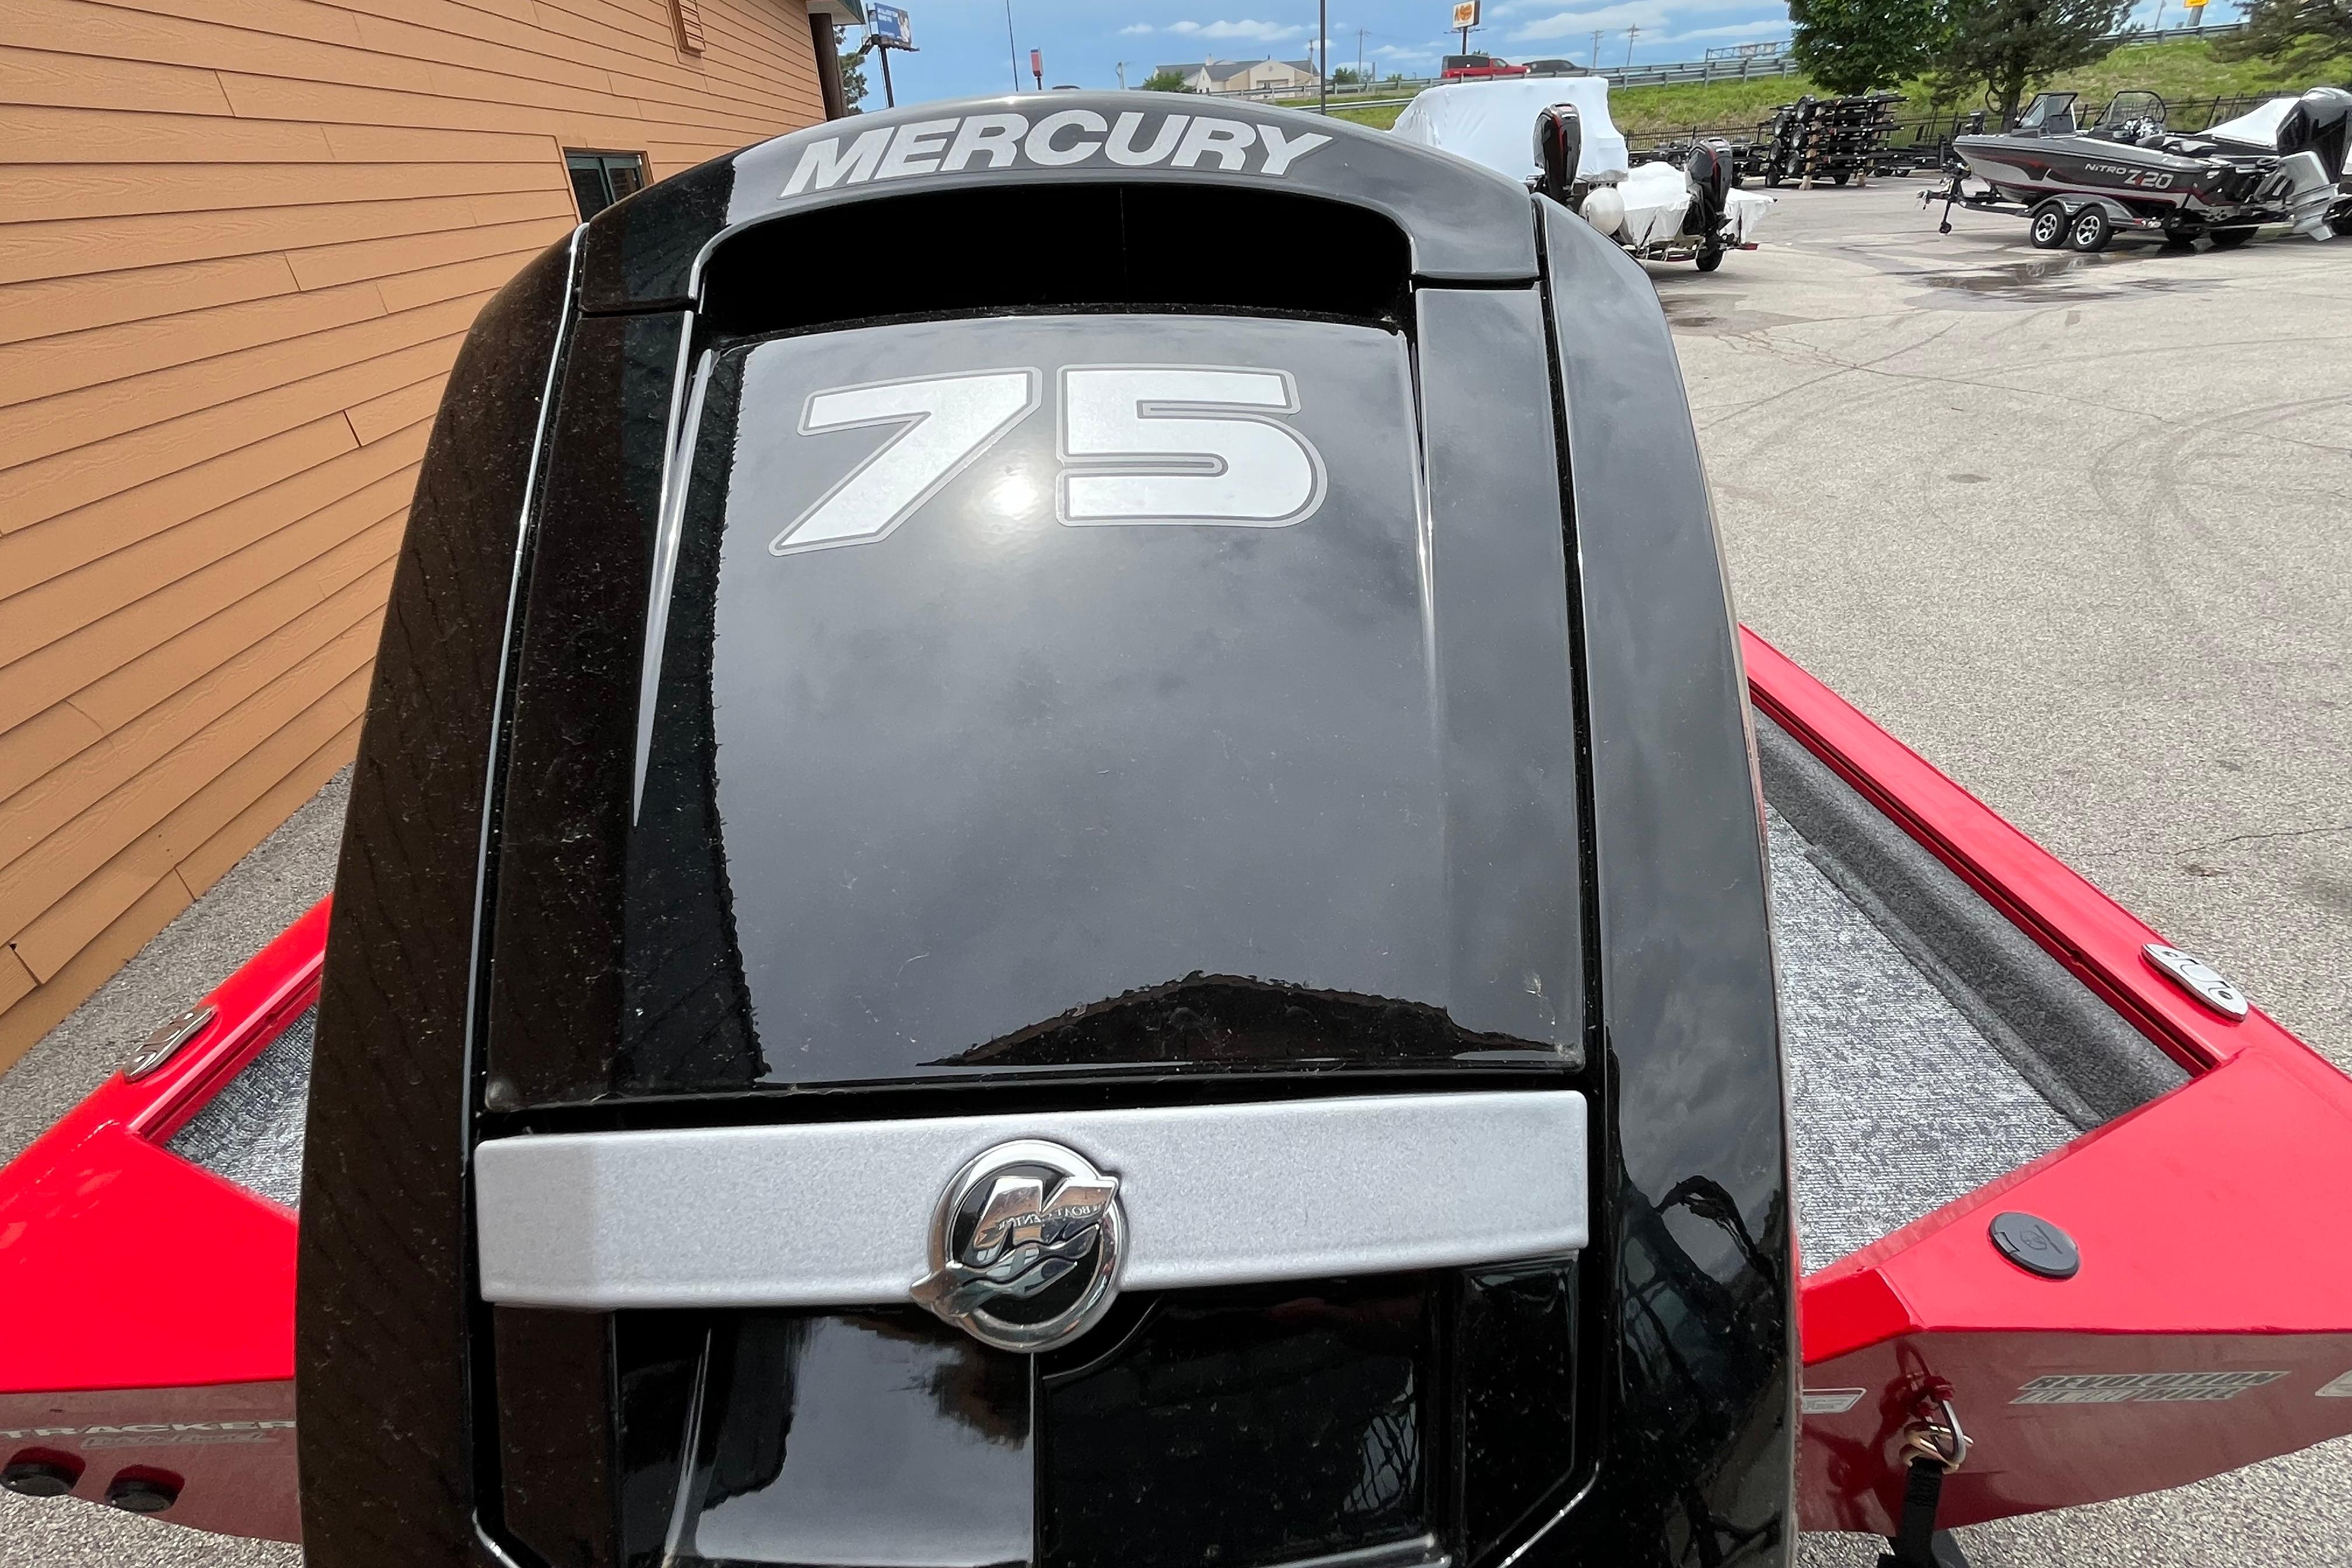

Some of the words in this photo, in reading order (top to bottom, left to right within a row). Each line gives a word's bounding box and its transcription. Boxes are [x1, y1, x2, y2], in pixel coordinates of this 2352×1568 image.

[779, 109, 1332, 198] MERCURY
[768, 363, 1328, 557] 75
[2020, 1371, 2288, 1390] REVOLUTION
[0, 1420, 296, 1438] TRACKER
